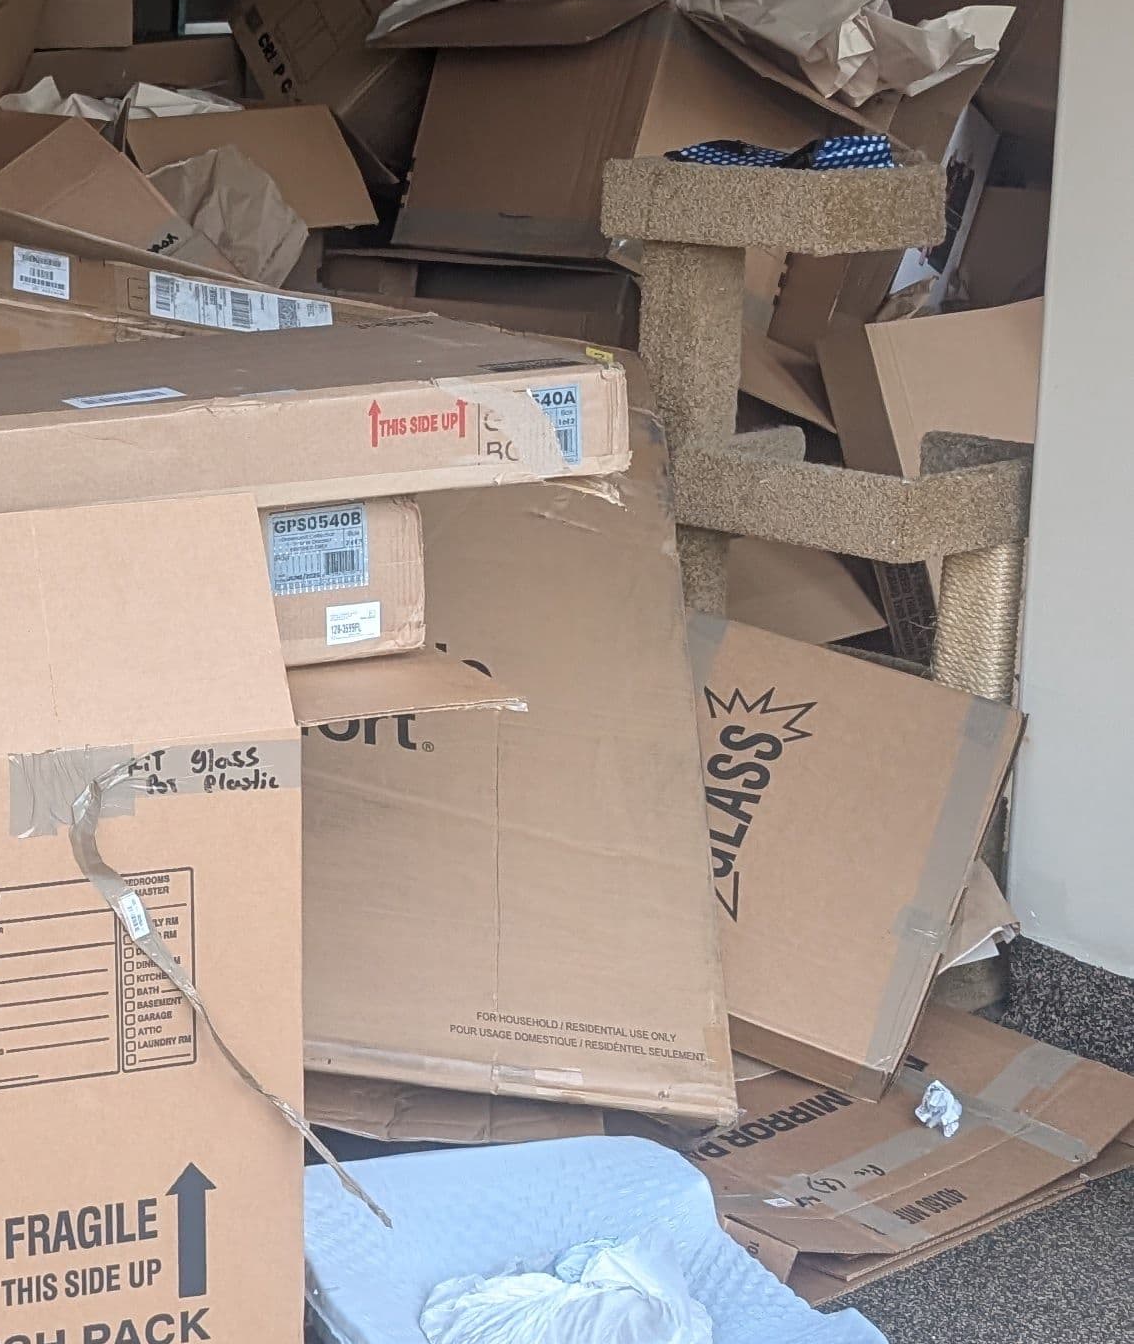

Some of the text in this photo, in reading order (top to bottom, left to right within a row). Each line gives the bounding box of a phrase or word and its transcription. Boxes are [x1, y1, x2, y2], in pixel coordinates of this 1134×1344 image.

[378, 412, 458, 437] THIS SIDE UP
[274, 511, 362, 534] GPS0540B
[137, 986, 159, 996] BATH
[137, 996, 183, 1009] BASEMENT
[137, 1011, 173, 1023] GARAGE
[476, 1011, 497, 1023] FOR
[498, 1013, 559, 1030] HOUSEHOLD
[565, 1021, 628, 1038] RESIDENTIAL
[629, 1029, 649, 1041] USE
[651, 1032, 677, 1043] ONLY
[137, 1025, 162, 1036] ATTIC
[137, 1035, 192, 1050] LAUNDRY RM
[449, 1024, 478, 1036] POUR
[479, 1027, 512, 1041] USAGE
[514, 1031, 578, 1048] DOMESTIQUE
[648, 1046, 706, 1061] SEULEMENT
[719, 1090, 854, 1148] MIRROR
[914, 1187, 968, 1214] 40X60
[4, 1197, 158, 1260] FRAGILE
[1, 1258, 162, 1307] THIS SIDE UP
